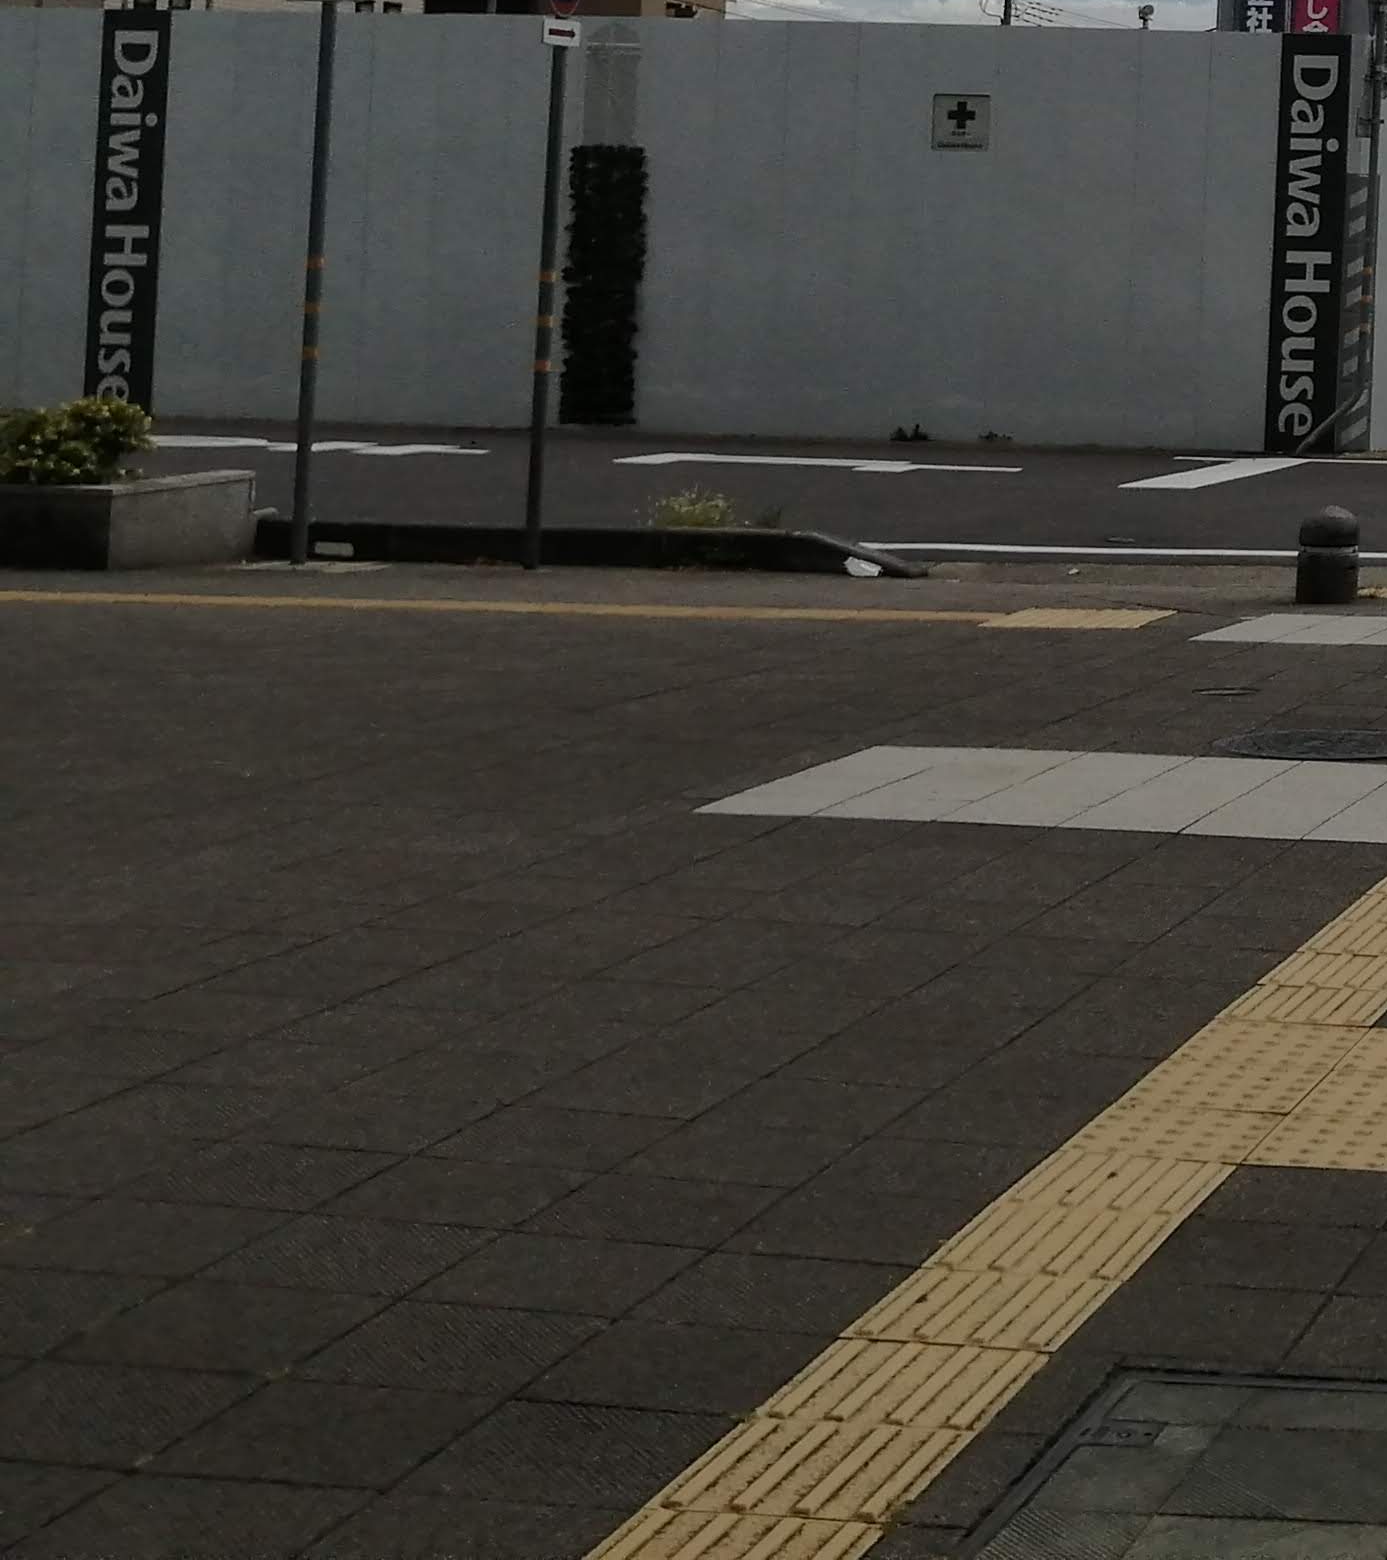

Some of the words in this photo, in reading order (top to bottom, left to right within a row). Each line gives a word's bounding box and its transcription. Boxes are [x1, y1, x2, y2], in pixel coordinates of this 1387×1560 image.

[105, 29, 159, 212] Daiwa
[1285, 53, 1340, 238] Daiwa
[1278, 249, 1333, 438] House
